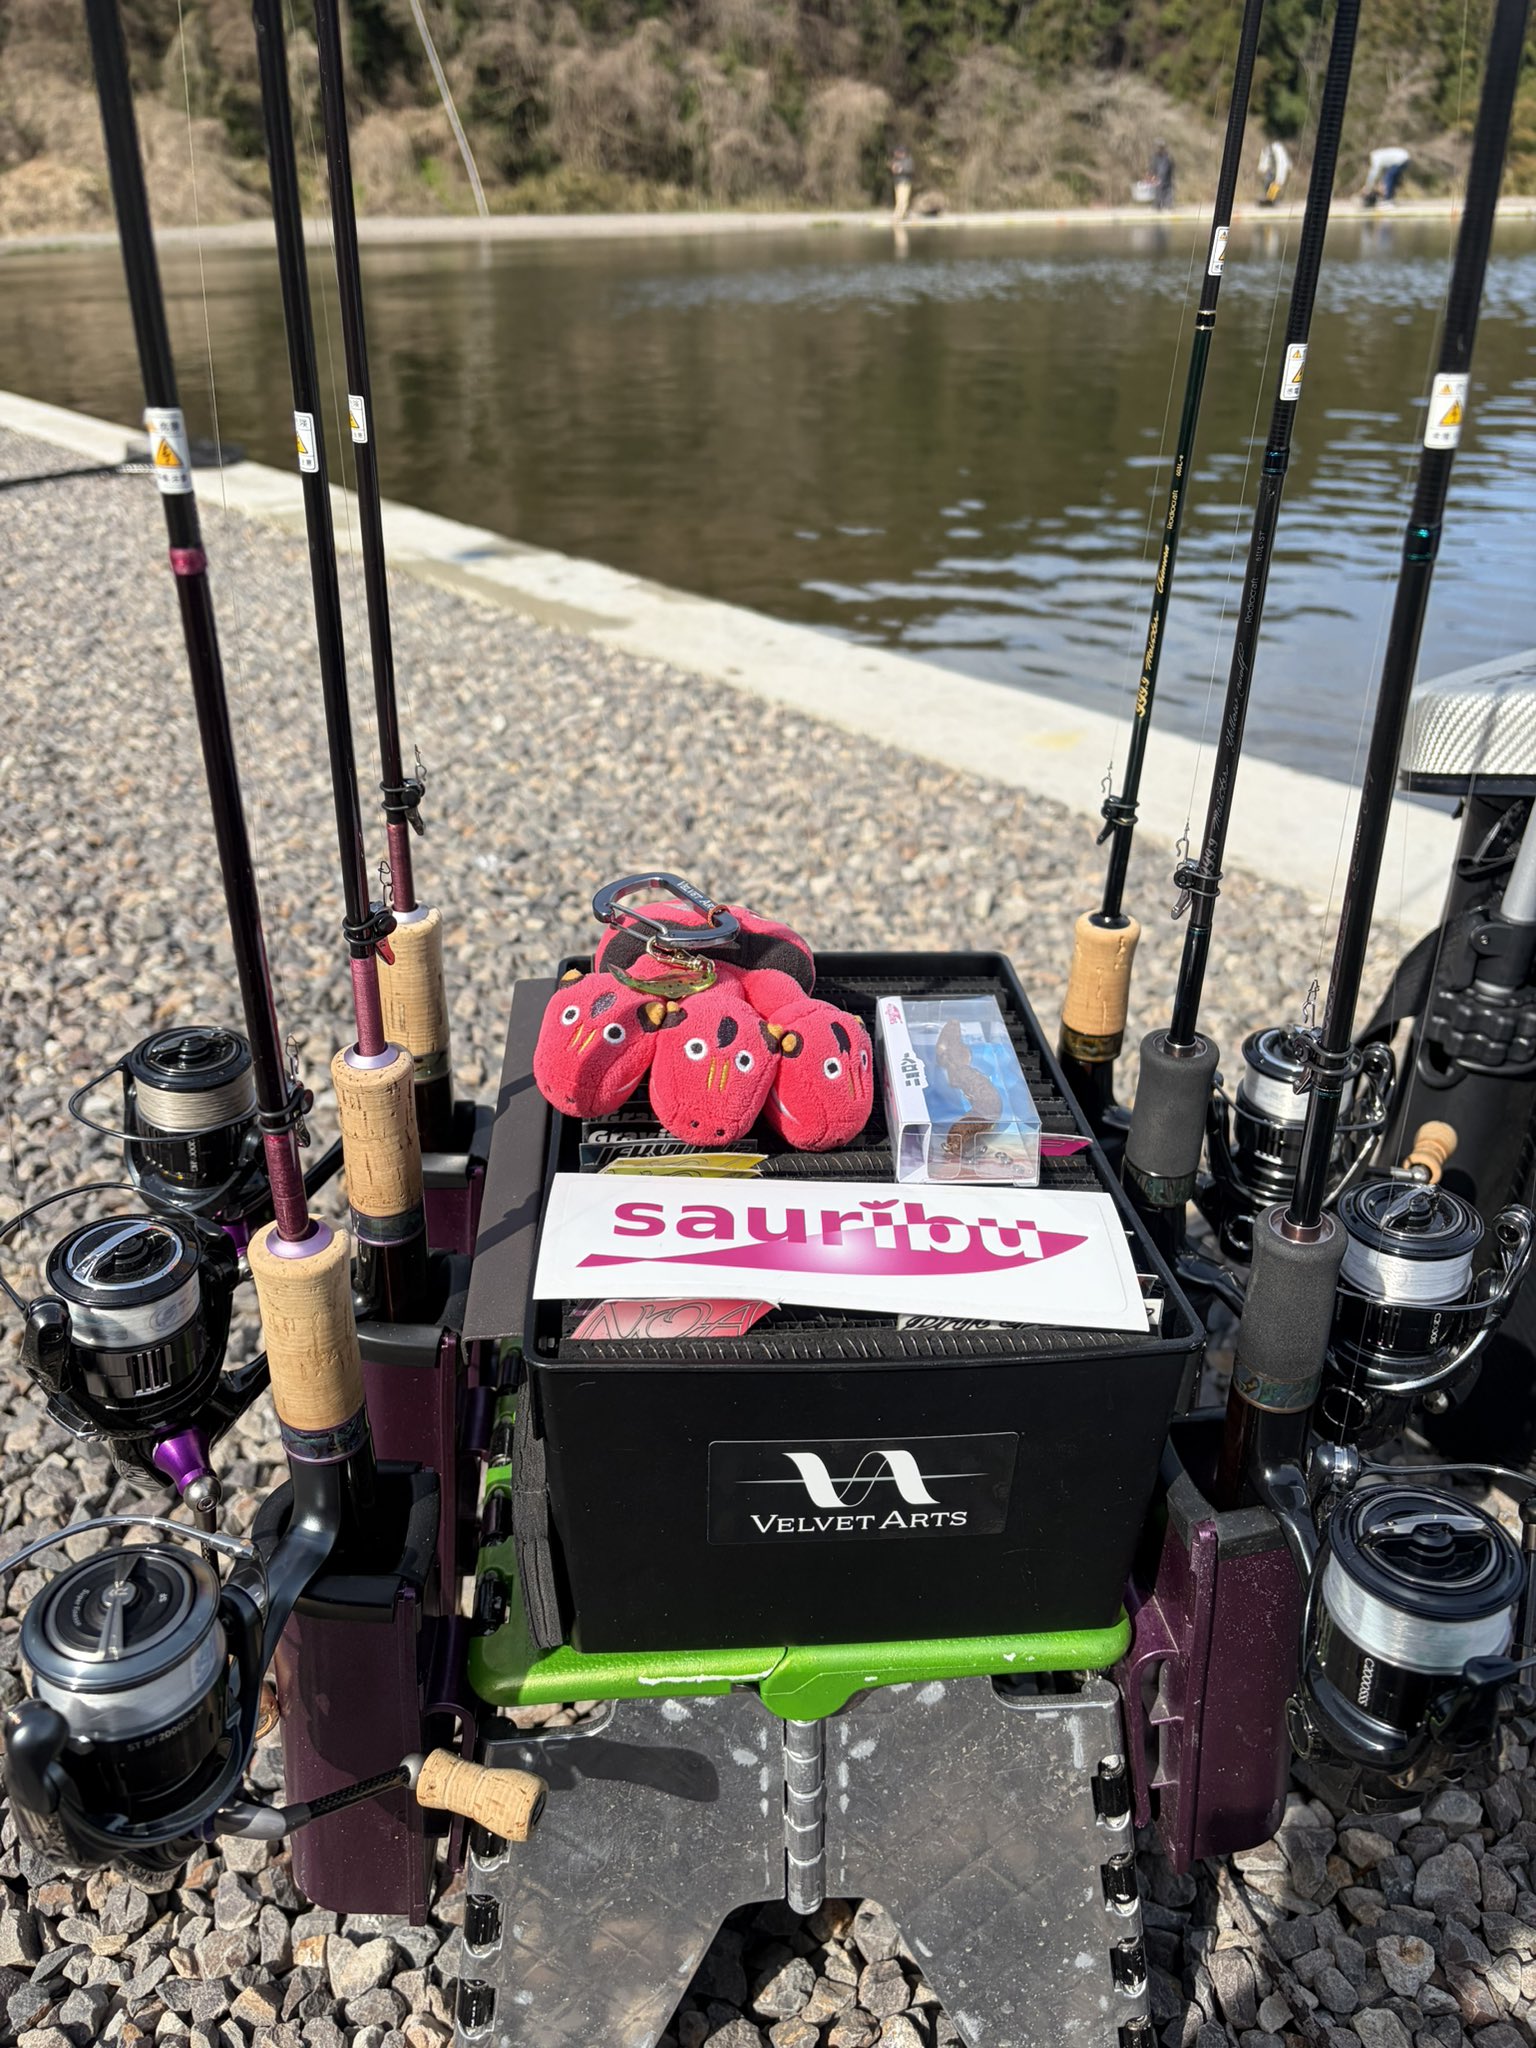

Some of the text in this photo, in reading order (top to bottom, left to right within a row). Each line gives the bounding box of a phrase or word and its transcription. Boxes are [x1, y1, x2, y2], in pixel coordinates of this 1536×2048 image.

[613, 1199, 1045, 1259] sauribu
[750, 1510, 968, 1534] VELVET ARTS
